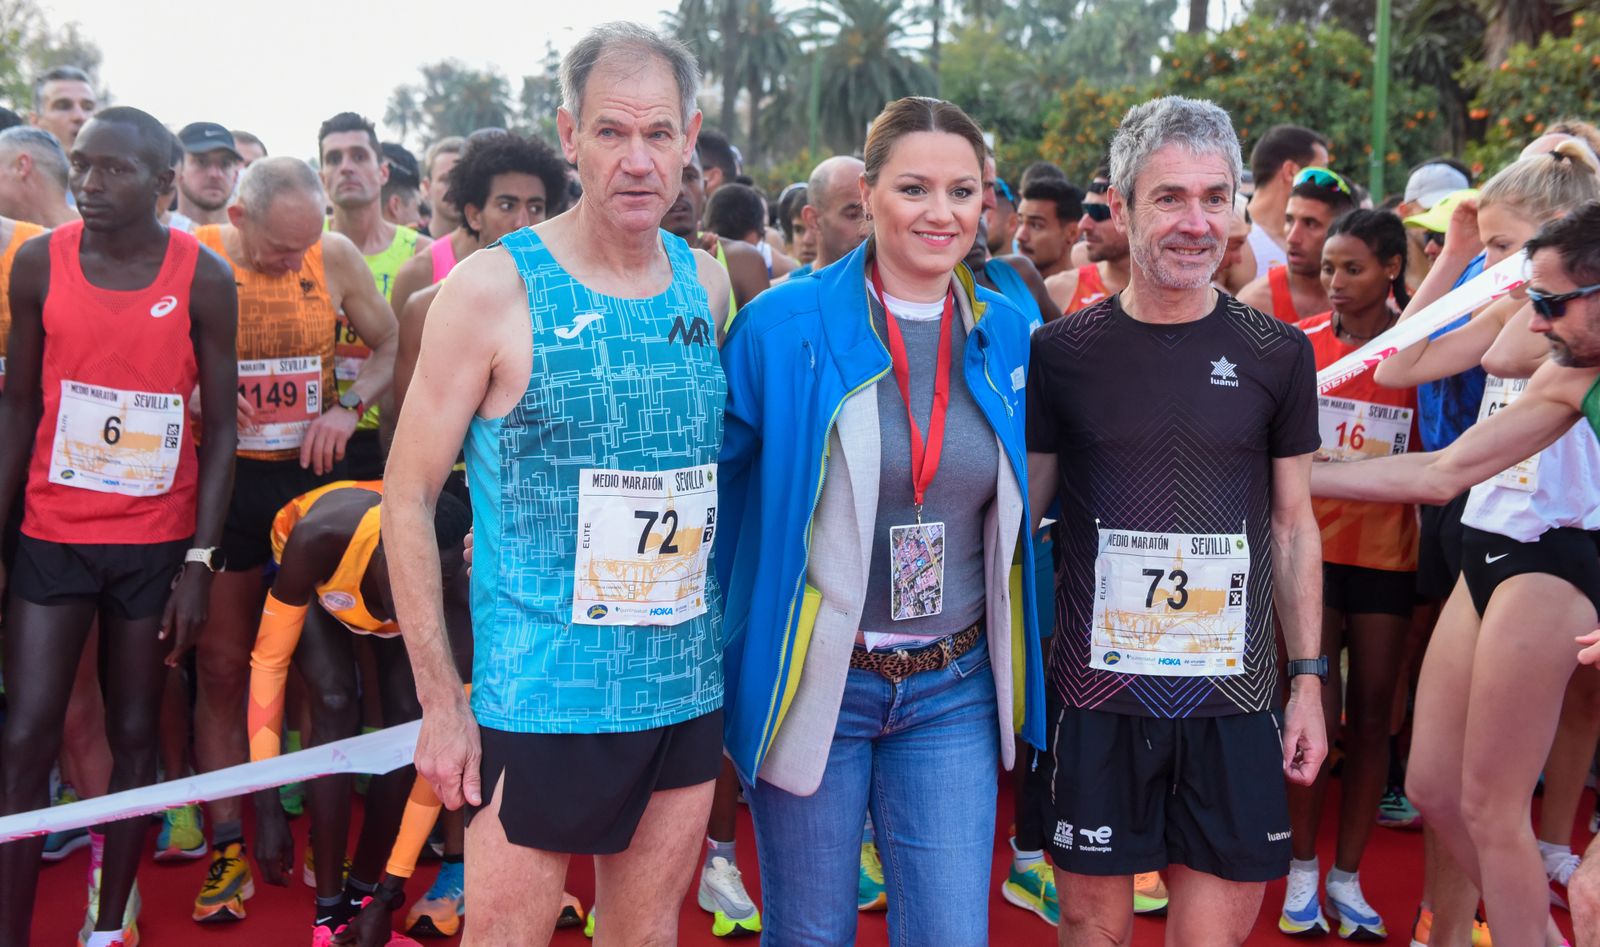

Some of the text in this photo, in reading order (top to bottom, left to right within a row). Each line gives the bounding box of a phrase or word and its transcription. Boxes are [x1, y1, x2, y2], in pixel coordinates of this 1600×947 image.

[280, 359, 307, 372] SEVILLA
[1210, 376, 1239, 387] luanvi
[70, 384, 169, 410] MEDIO MARATÓN SEVILLA
[1368, 405, 1399, 420] SEVILLA
[103, 416, 122, 445] 6
[1335, 420, 1366, 451] 16
[592, 470, 705, 492] MEDIO MARATÓN SEVILLA
[582, 522, 592, 549] ELITE
[634, 509, 679, 555] 72
[1131, 535, 1169, 550] MARATÓN
[1191, 537, 1232, 555] SEVILLA
[1142, 568, 1189, 610] 73
[649, 607, 674, 616] HOKA
[1157, 657, 1181, 666] HOKA
